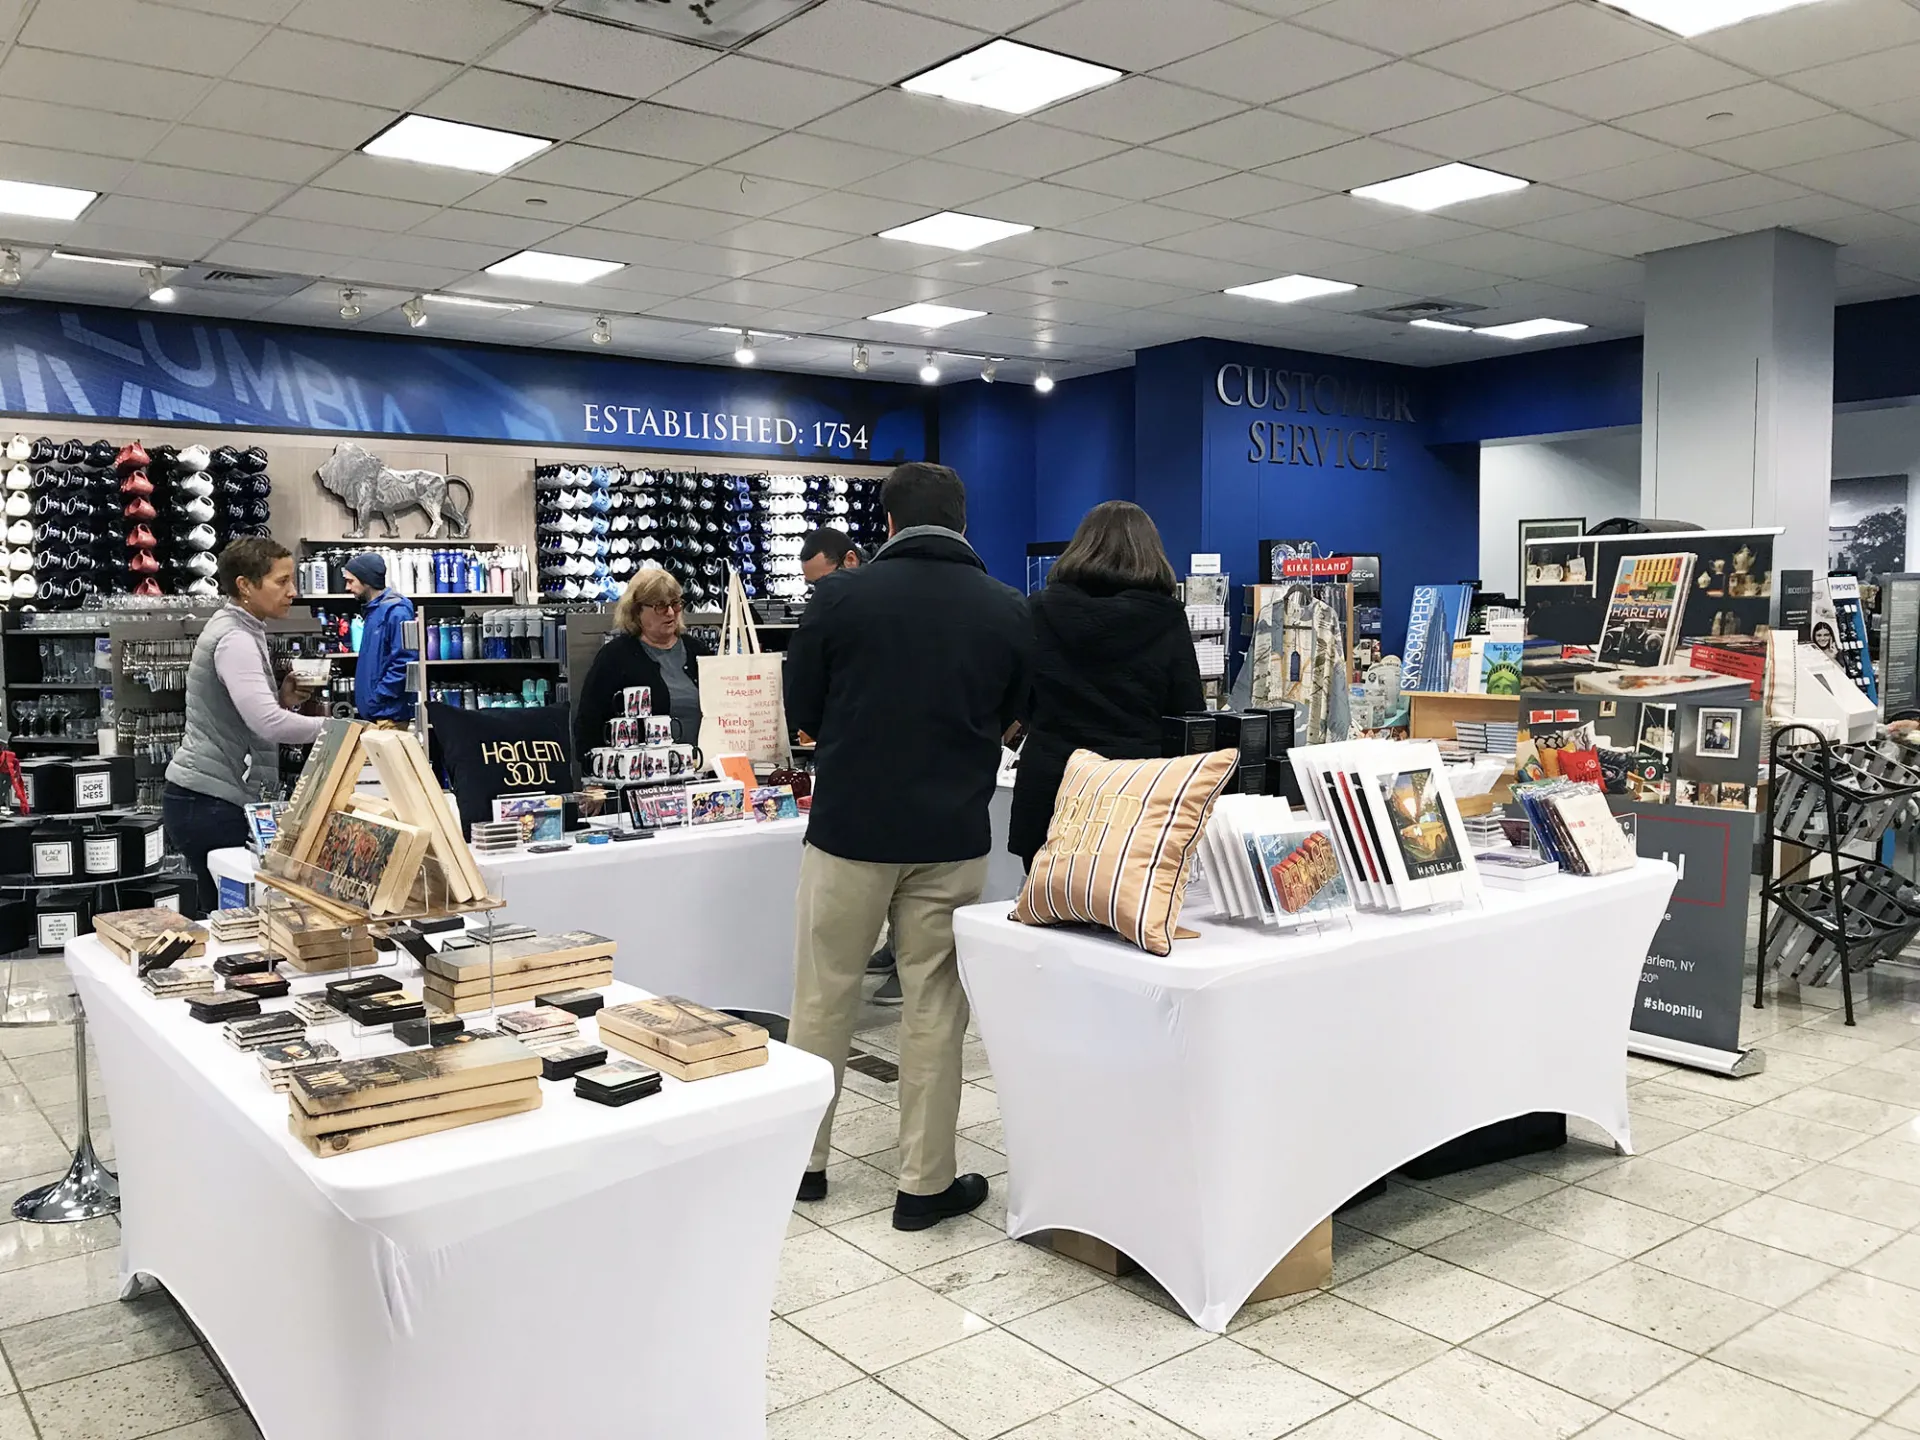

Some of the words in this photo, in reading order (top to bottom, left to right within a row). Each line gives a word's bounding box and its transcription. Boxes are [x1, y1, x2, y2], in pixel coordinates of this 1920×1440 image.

[1216, 363, 1417, 424] CUSTOMER
[583, 403, 804, 446] ESTABLISHED:
[812, 421, 869, 450] 1754
[1248, 420, 1388, 471] SERVICE
[1611, 607, 1669, 619] HARLEM
[1400, 587, 1432, 690] SKYSCRAPERS
[308, 728, 329, 762] CITY
[503, 762, 556, 786] SOUL
[82, 791, 104, 799] NESS
[287, 774, 309, 814] YORK
[1417, 862, 1454, 876] HARLEM
[1680, 959, 1696, 973] NY
[1643, 996, 1704, 1020] #shopnilu
